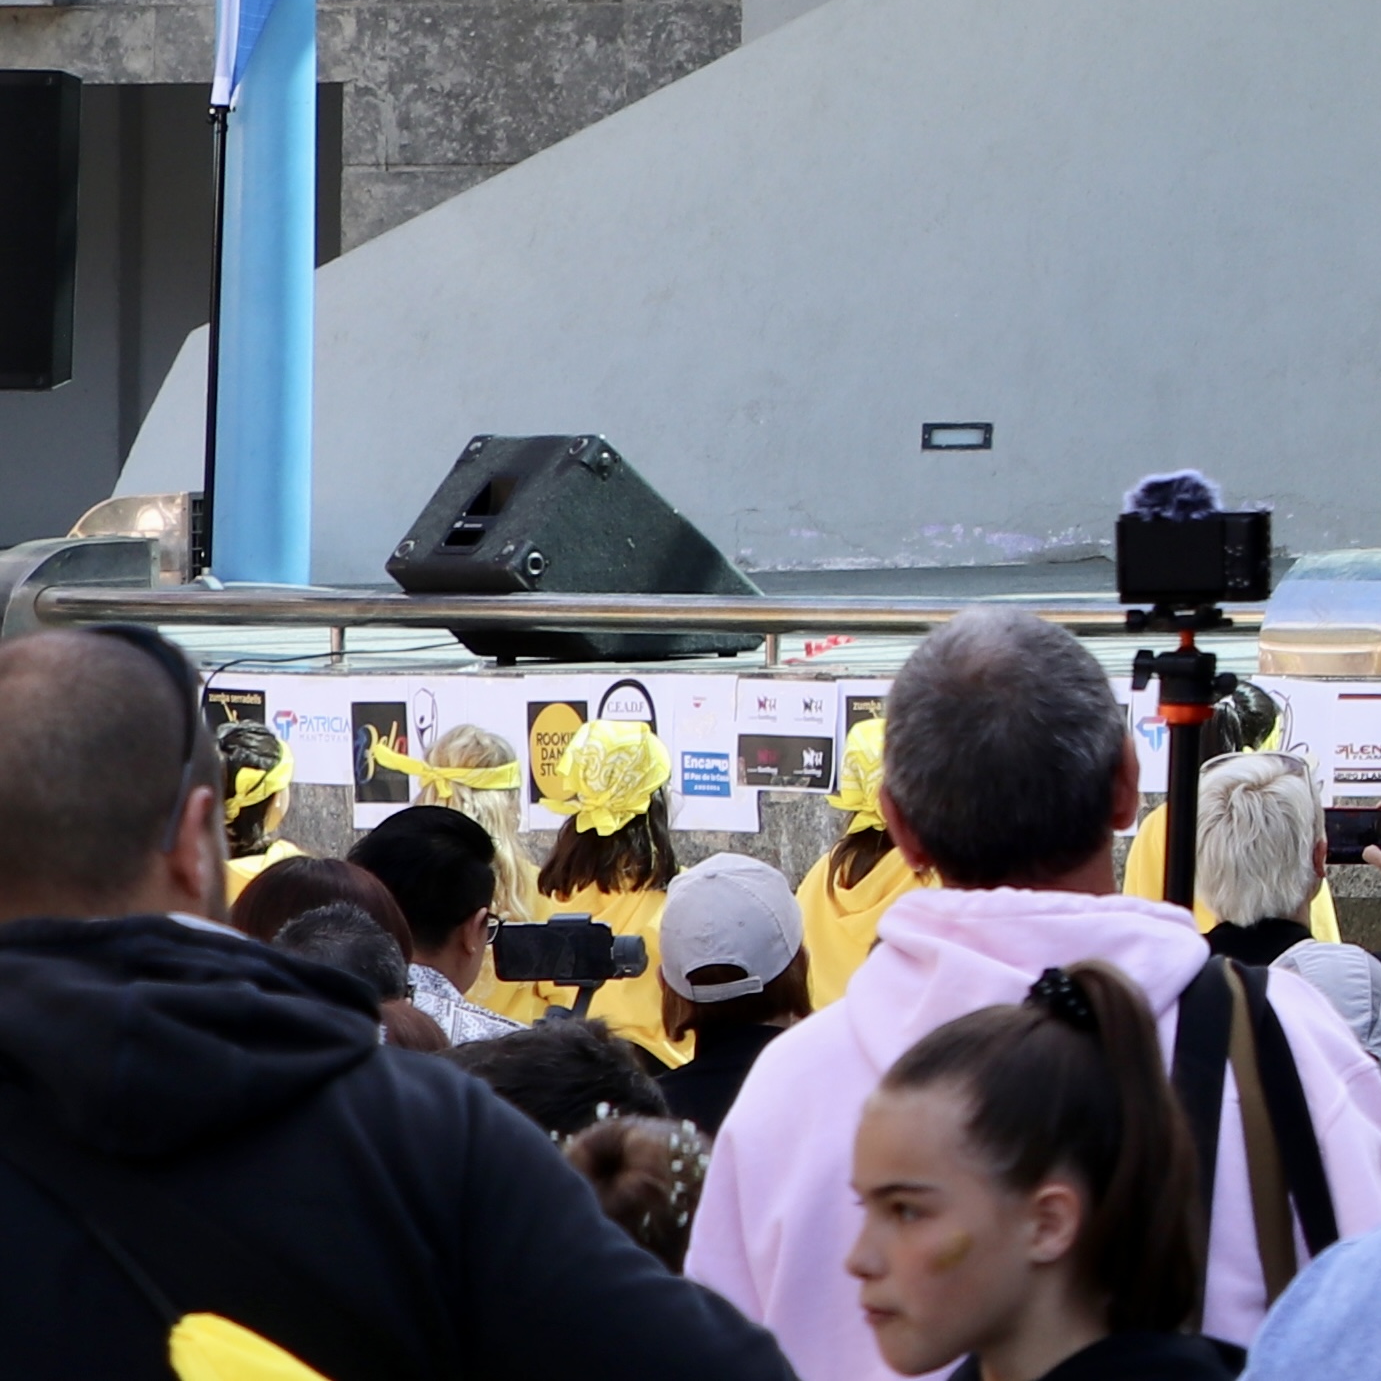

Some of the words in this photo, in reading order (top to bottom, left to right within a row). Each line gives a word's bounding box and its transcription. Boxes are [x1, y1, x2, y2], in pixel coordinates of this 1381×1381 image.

[852, 701, 882, 713] zumba
[299, 715, 351, 733] PATRICIA
[536, 731, 575, 746] ROOKI
[541, 747, 565, 761] DAN
[683, 754, 729, 772] Encamp
